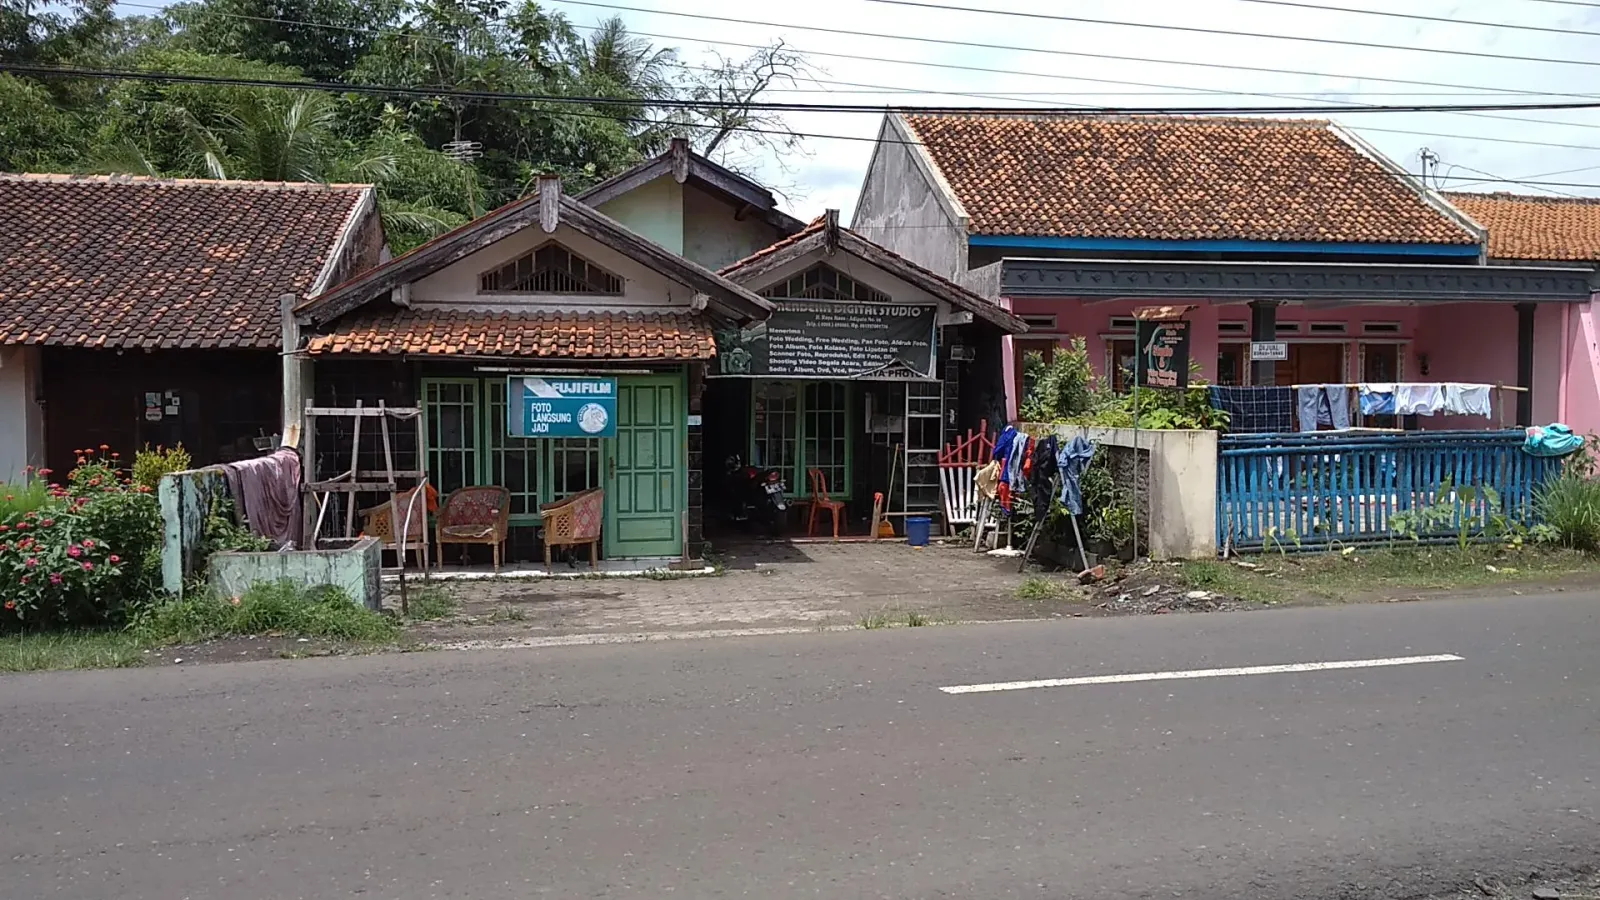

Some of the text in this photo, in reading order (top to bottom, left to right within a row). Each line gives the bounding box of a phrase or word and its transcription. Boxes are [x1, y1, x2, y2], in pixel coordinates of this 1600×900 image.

[834, 304, 877, 316] DIGITAL
[880, 306, 921, 317] STUDIO
[551, 382, 611, 394] FUJIFILM
[531, 403, 552, 412] FOTO
[531, 413, 572, 423] LANGSUNG
[531, 423, 549, 433] JADI
